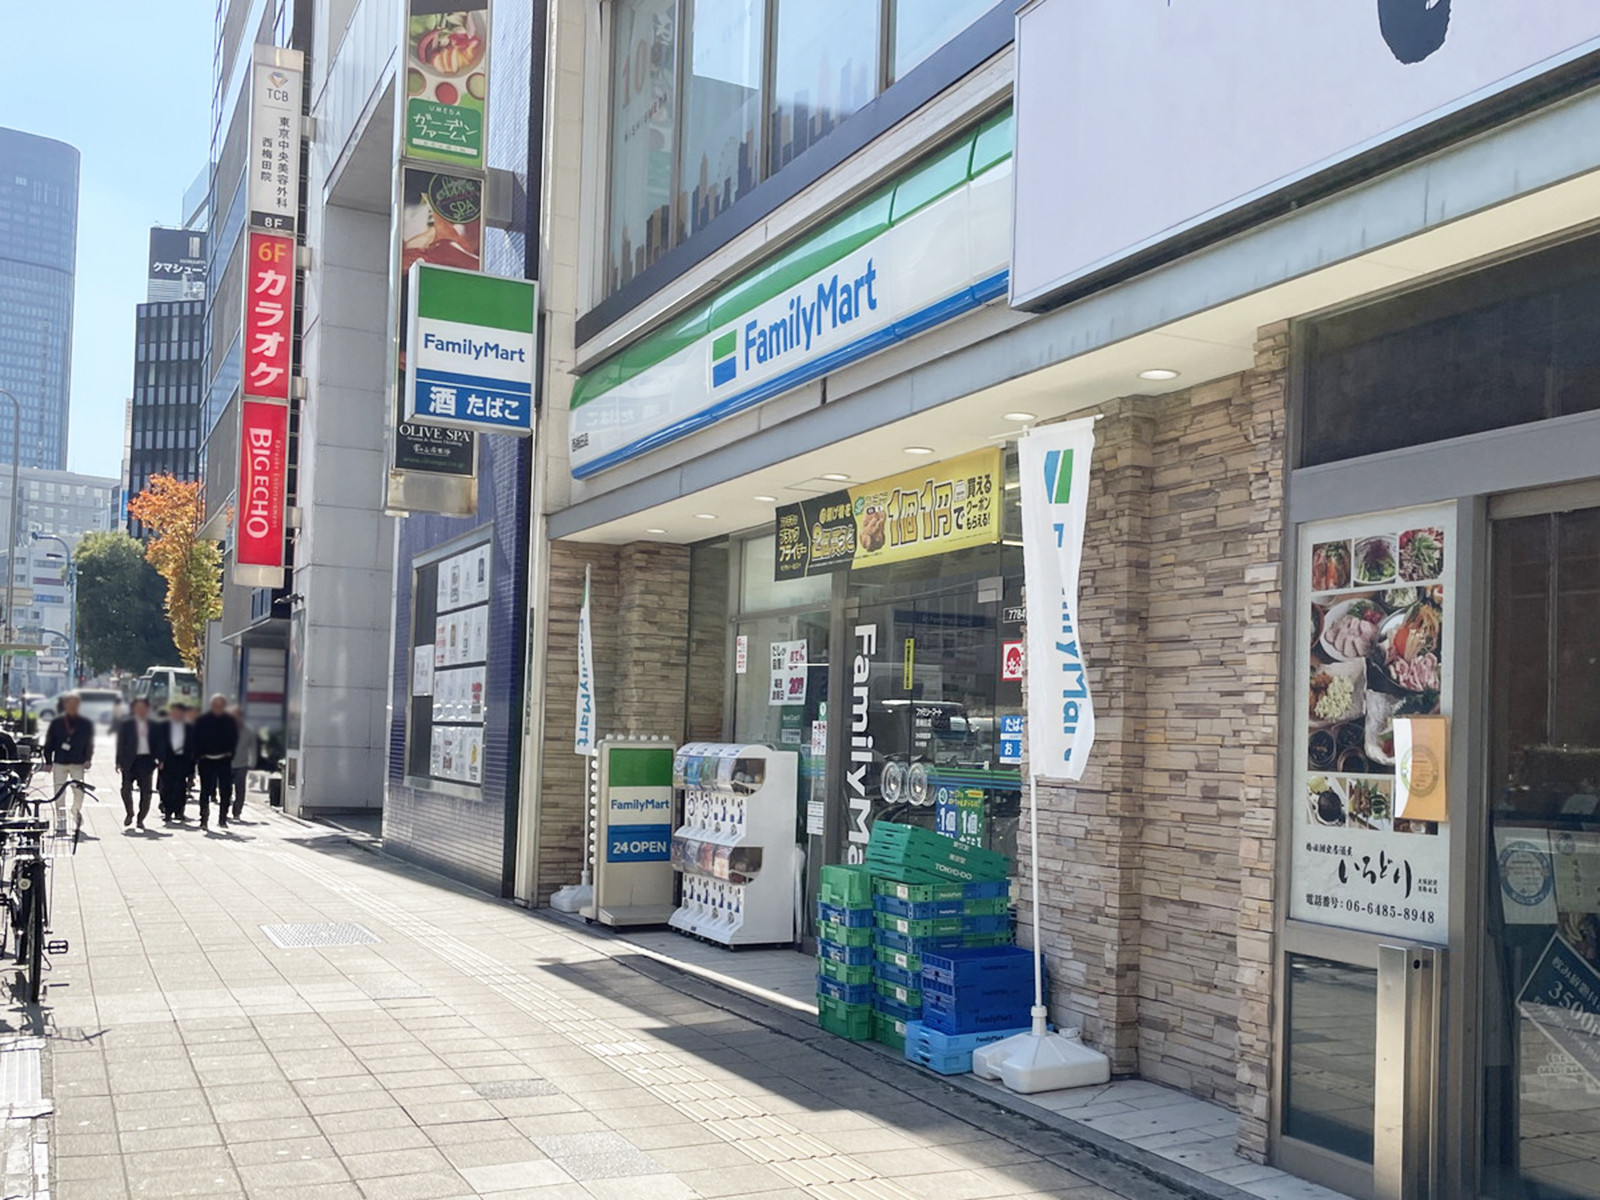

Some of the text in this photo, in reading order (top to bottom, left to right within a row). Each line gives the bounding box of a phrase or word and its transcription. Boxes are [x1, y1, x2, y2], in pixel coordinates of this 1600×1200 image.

[267, 88, 289, 102] TCB
[412, 113, 478, 135] ガーデン
[416, 124, 467, 143] ファーム
[260, 137, 273, 182] 西梅田院
[276, 116, 291, 208] 東京中央美容外科
[449, 199, 477, 219] SPA
[264, 217, 283, 229] 8F
[258, 242, 287, 263] 6F
[745, 257, 877, 371] FamilyMart
[250, 269, 287, 387] カラオケ
[424, 333, 525, 362] FamilyMart
[429, 386, 520, 420] 酒 たばこ
[399, 424, 442, 439] OLIVE
[446, 429, 470, 442] SPA
[246, 427, 272, 538] BIG ECHO
[966, 474, 992, 499] 買える
[966, 496, 992, 515] クーポン
[953, 506, 965, 530] で
[966, 512, 991, 530] もらえる!
[611, 799, 670, 812] FamilyMart
[613, 841, 667, 854] 24 OPEN
[1338, 850, 1412, 899] いろどり
